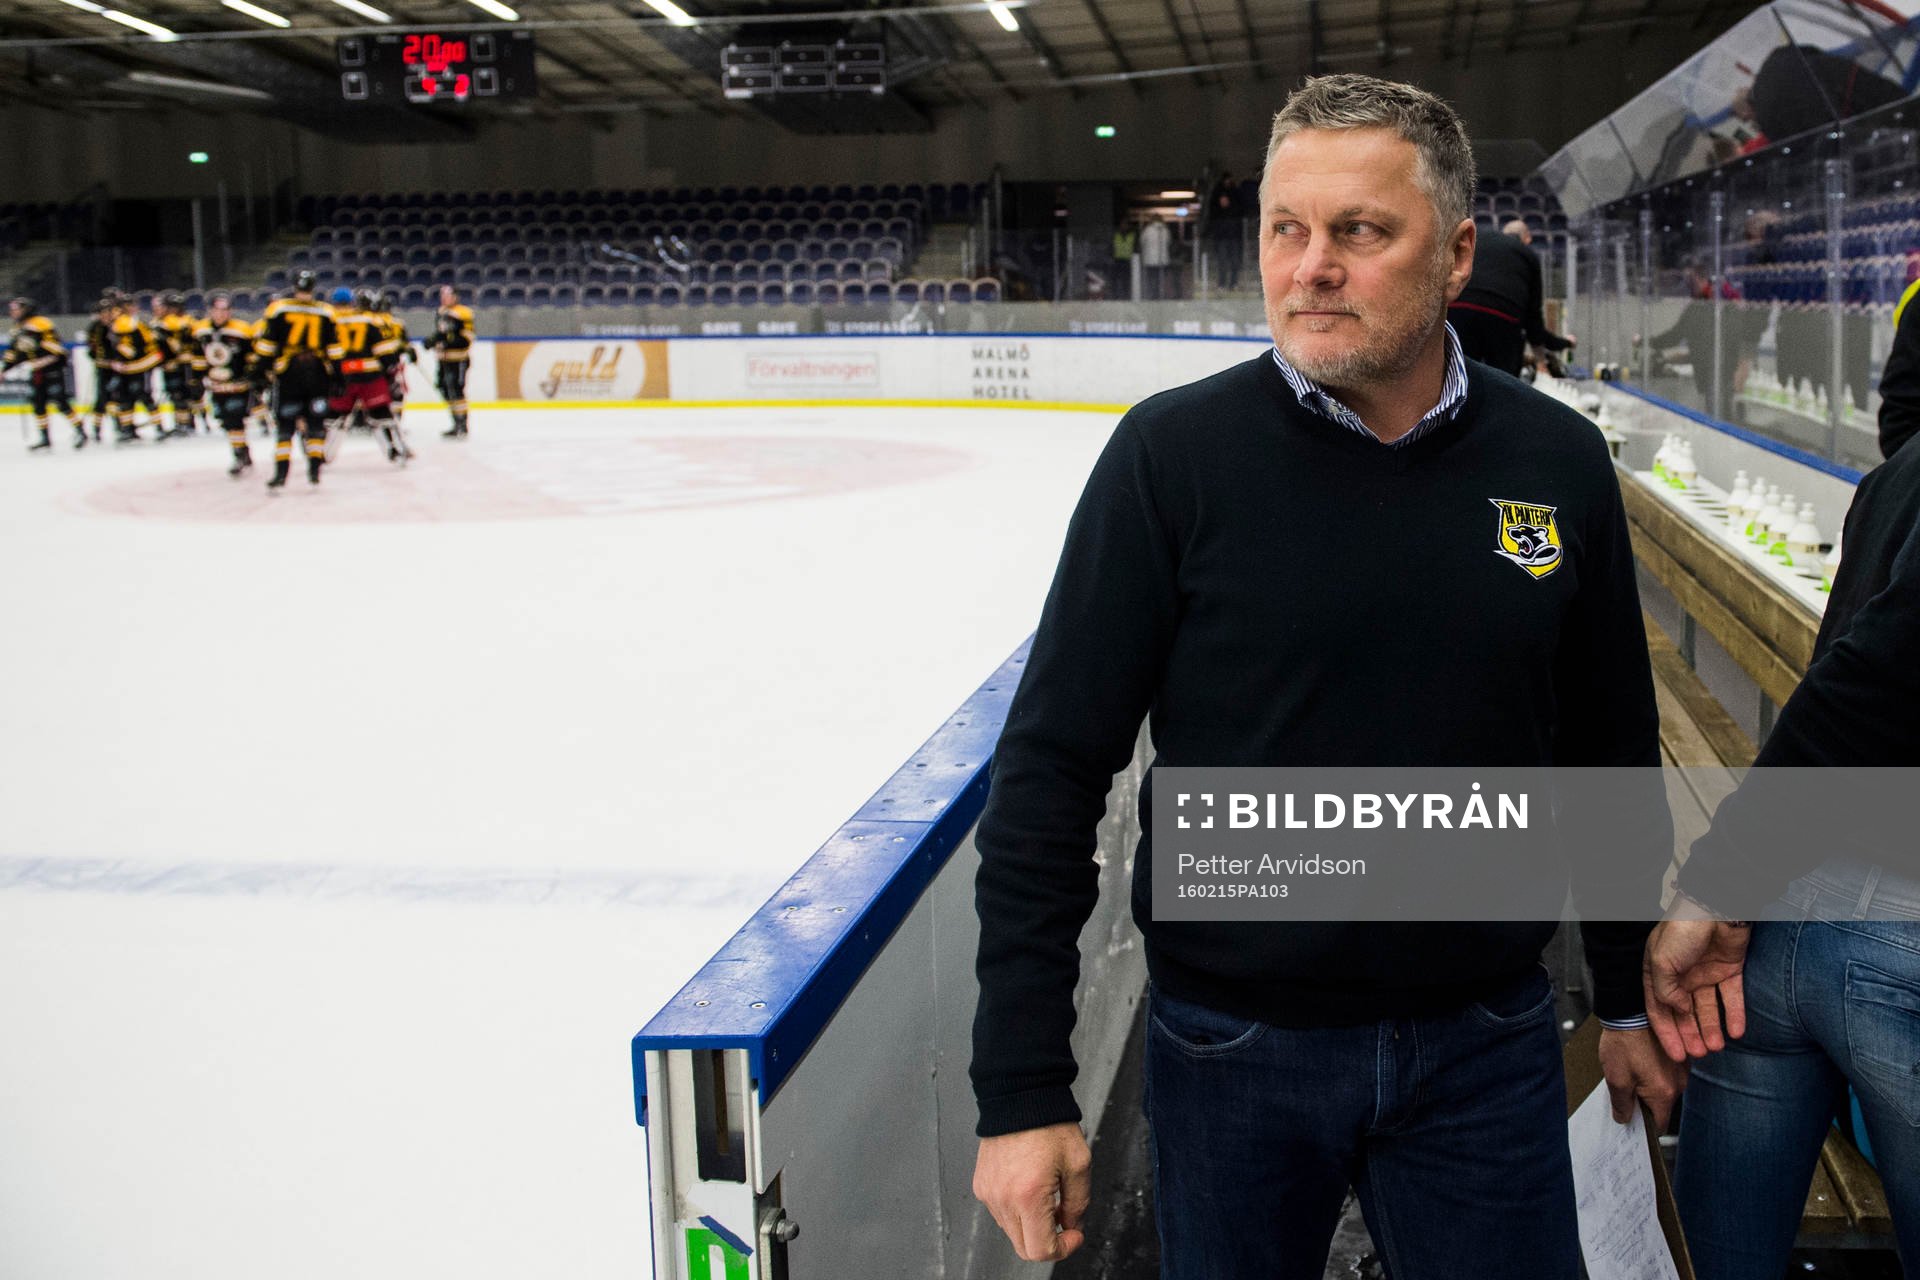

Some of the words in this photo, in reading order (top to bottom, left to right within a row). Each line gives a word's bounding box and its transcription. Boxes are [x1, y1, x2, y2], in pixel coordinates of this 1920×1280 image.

[285, 311, 321, 350] 71
[972, 343, 1031, 361] MALMÖ
[538, 346, 623, 398] guld
[972, 366, 1031, 380] ARENA
[973, 385, 1032, 400] HOTEL
